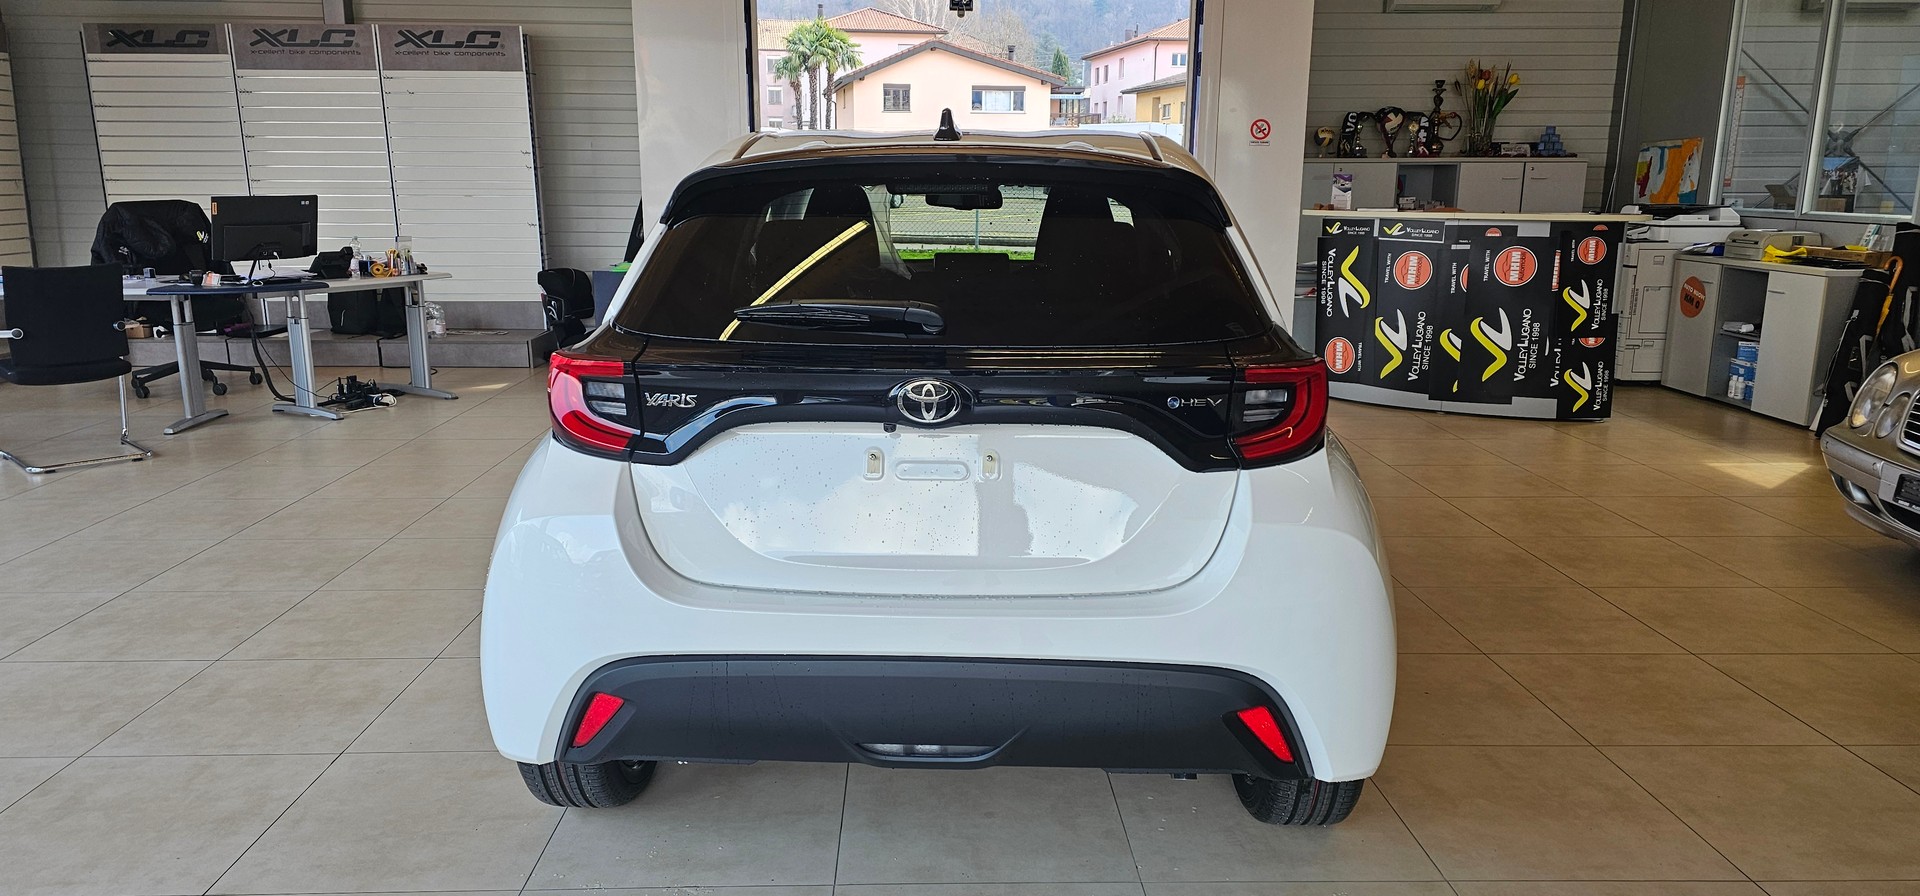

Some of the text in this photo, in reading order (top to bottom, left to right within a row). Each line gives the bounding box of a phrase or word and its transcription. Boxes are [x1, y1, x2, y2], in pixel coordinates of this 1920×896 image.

[106, 29, 210, 48] XLC
[249, 29, 356, 48] XLC
[394, 30, 501, 48] XLC
[1588, 239, 1596, 261] MHM
[1406, 255, 1418, 285] MHM
[1509, 251, 1521, 282] MHM
[1335, 341, 1343, 369] MHM
[1422, 325, 1434, 370] SINCE 1998
[1528, 322, 1541, 369] SINCE 1998
[644, 392, 698, 408] YARIS
[1180, 397, 1222, 407] HEV
